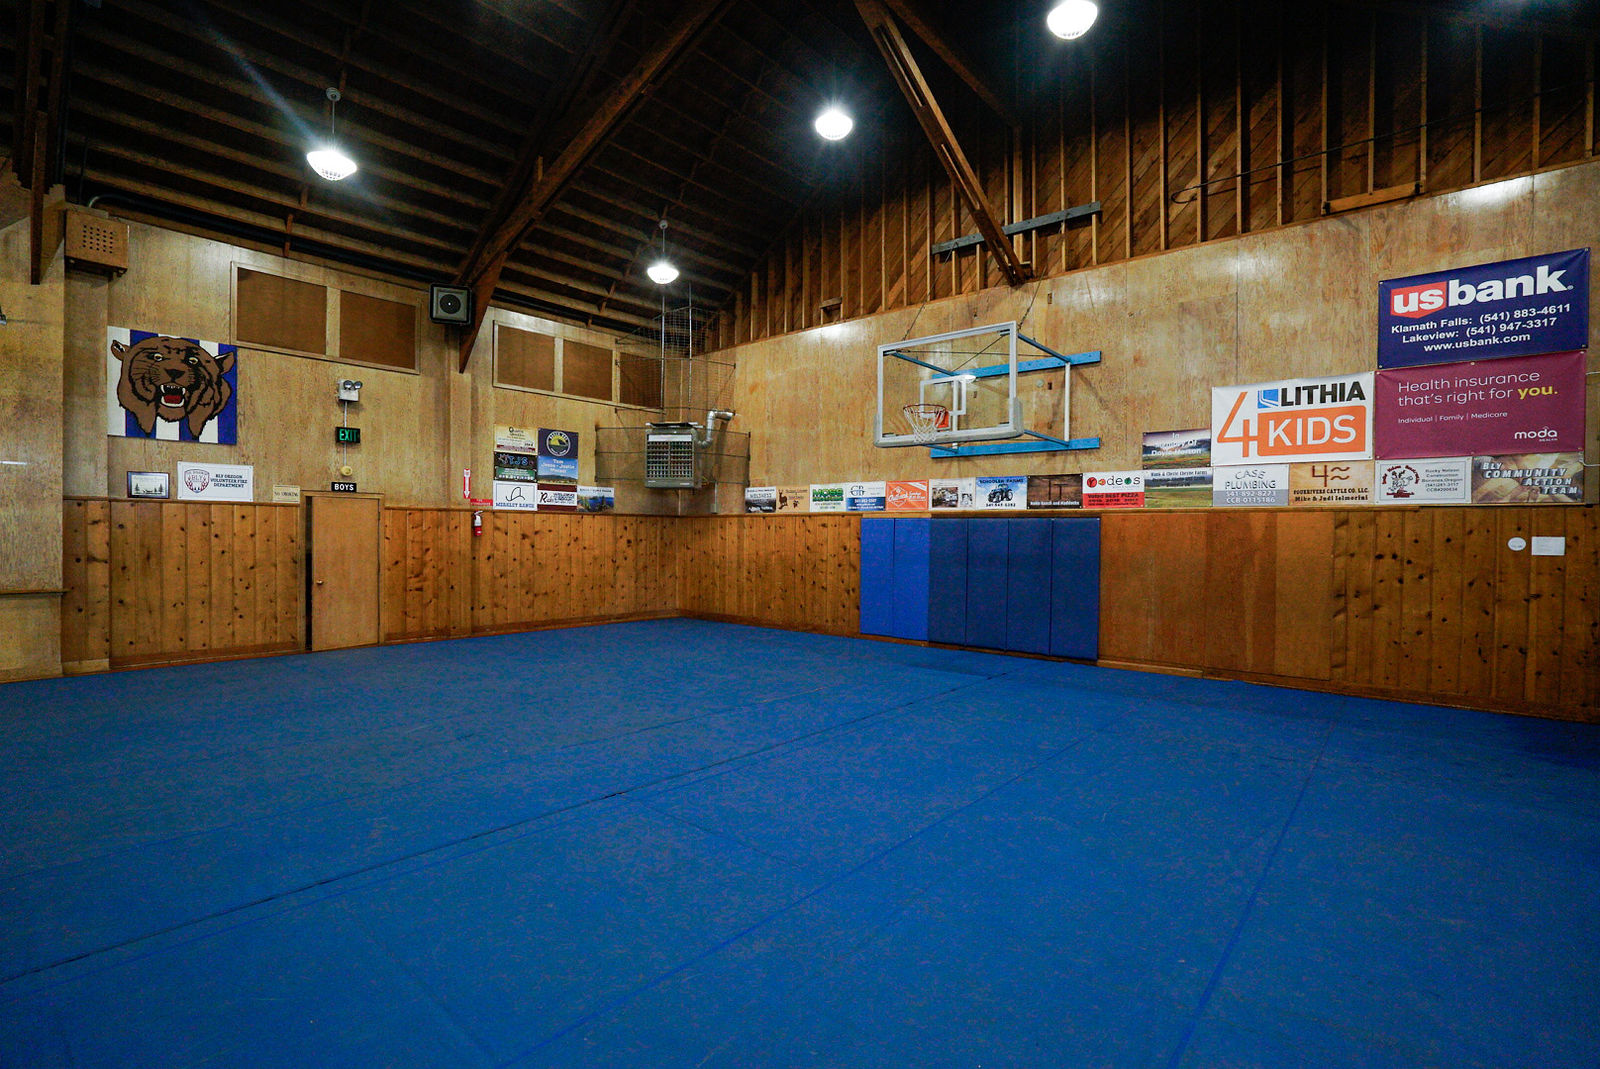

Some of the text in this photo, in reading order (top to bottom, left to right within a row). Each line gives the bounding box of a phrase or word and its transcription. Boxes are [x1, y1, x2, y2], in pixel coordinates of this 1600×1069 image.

[1391, 303, 1571, 334] Klamath Falls: (541) 883-4611
[1402, 317, 1557, 343] Lakeview: (541) 947-3317
[1423, 332, 1531, 352] www.usbank.com
[1398, 372, 1541, 393] Health insurance
[1281, 381, 1366, 407] LITHIA
[1398, 385, 1559, 407] that's right for you.
[1398, 411, 1508, 424] Individual Family Medicare
[1217, 391, 1357, 458] 4 KIDS
[339, 429, 358, 442] EXIT
[1514, 427, 1558, 440] moda
[1235, 469, 1266, 480] CASE
[1485, 468, 1567, 478] COMMUNITY
[334, 483, 354, 491] BOYS
[1225, 480, 1276, 490] PLUMBING
[1524, 478, 1572, 486] ACTION
[1543, 486, 1578, 494] TEAM
